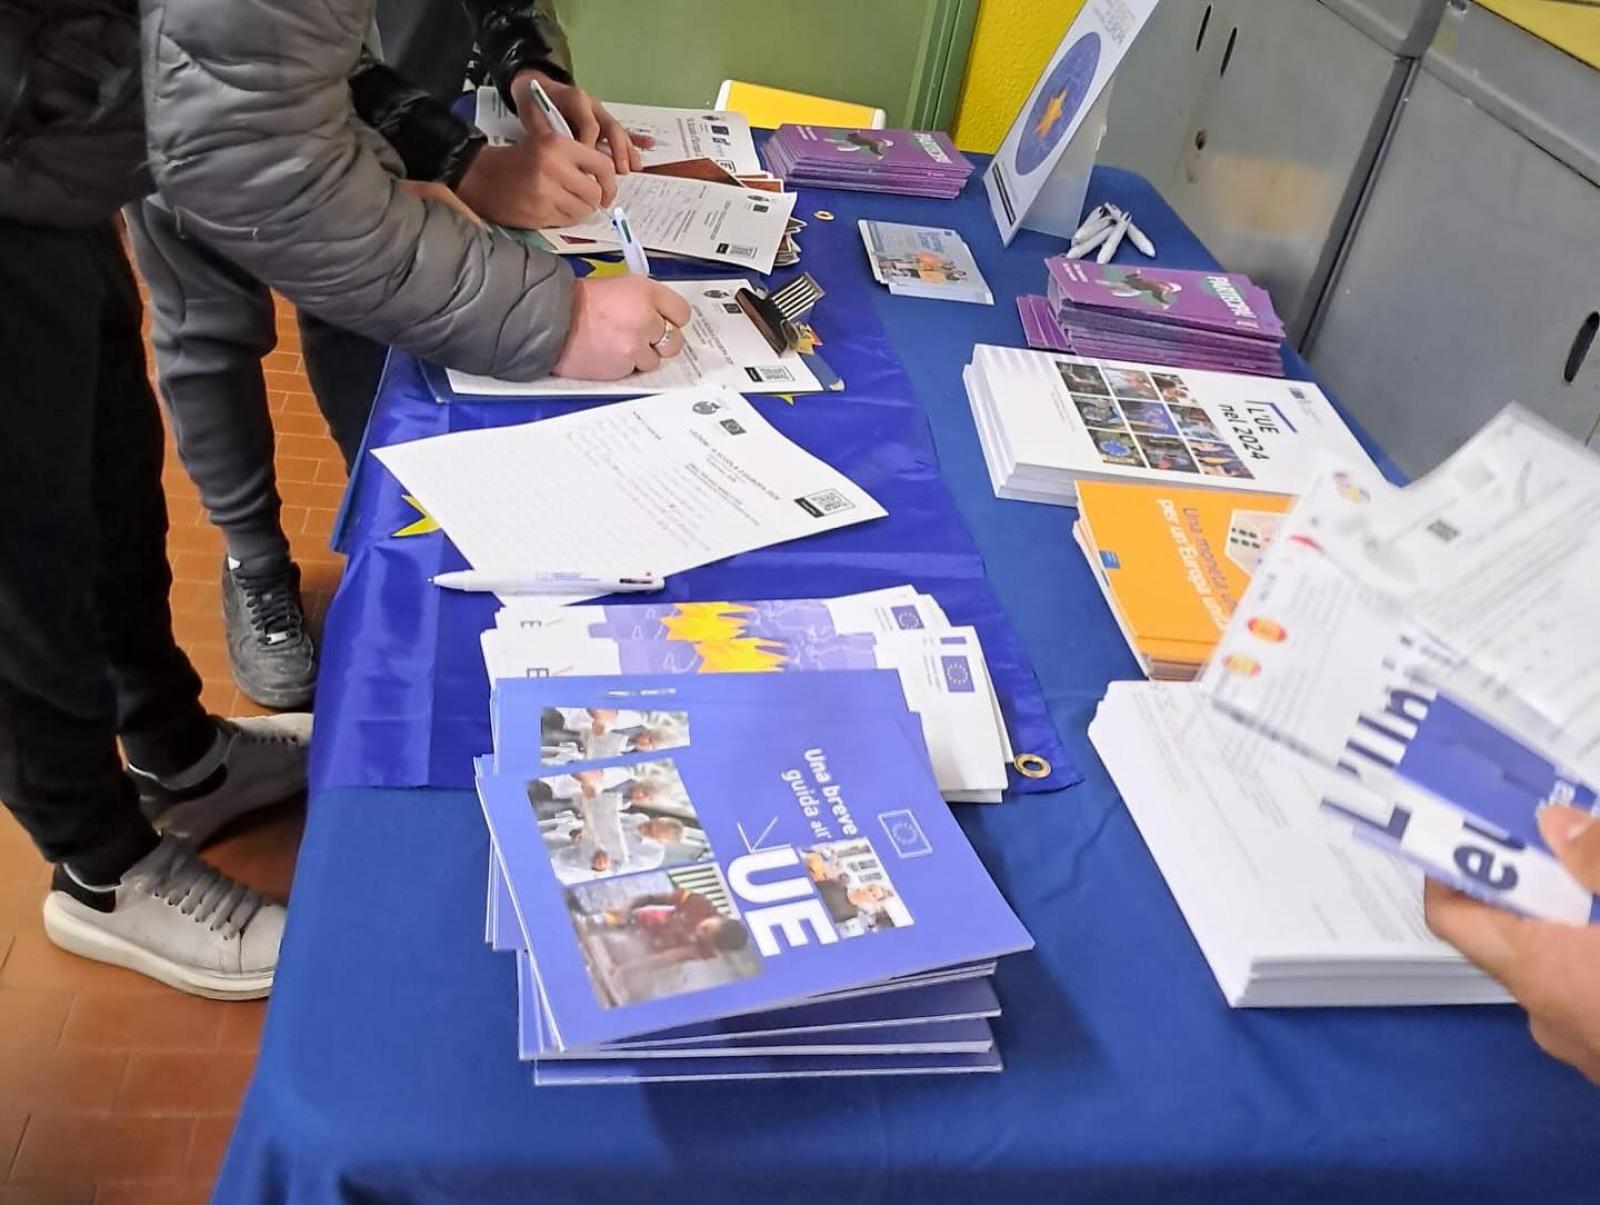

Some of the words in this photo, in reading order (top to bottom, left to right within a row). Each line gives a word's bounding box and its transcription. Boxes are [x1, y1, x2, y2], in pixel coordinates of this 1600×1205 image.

[1218, 403, 1247, 424] nel
[1233, 426, 1271, 461] 2024
[1247, 406, 1280, 434] L'UE
[1156, 498, 1181, 525] per
[1183, 507, 1203, 534] Una
[1198, 538, 1230, 590] moneta
[781, 768, 820, 817] guida
[804, 748, 831, 784] Una
[822, 785, 858, 836] breve
[727, 845, 839, 957] UE
